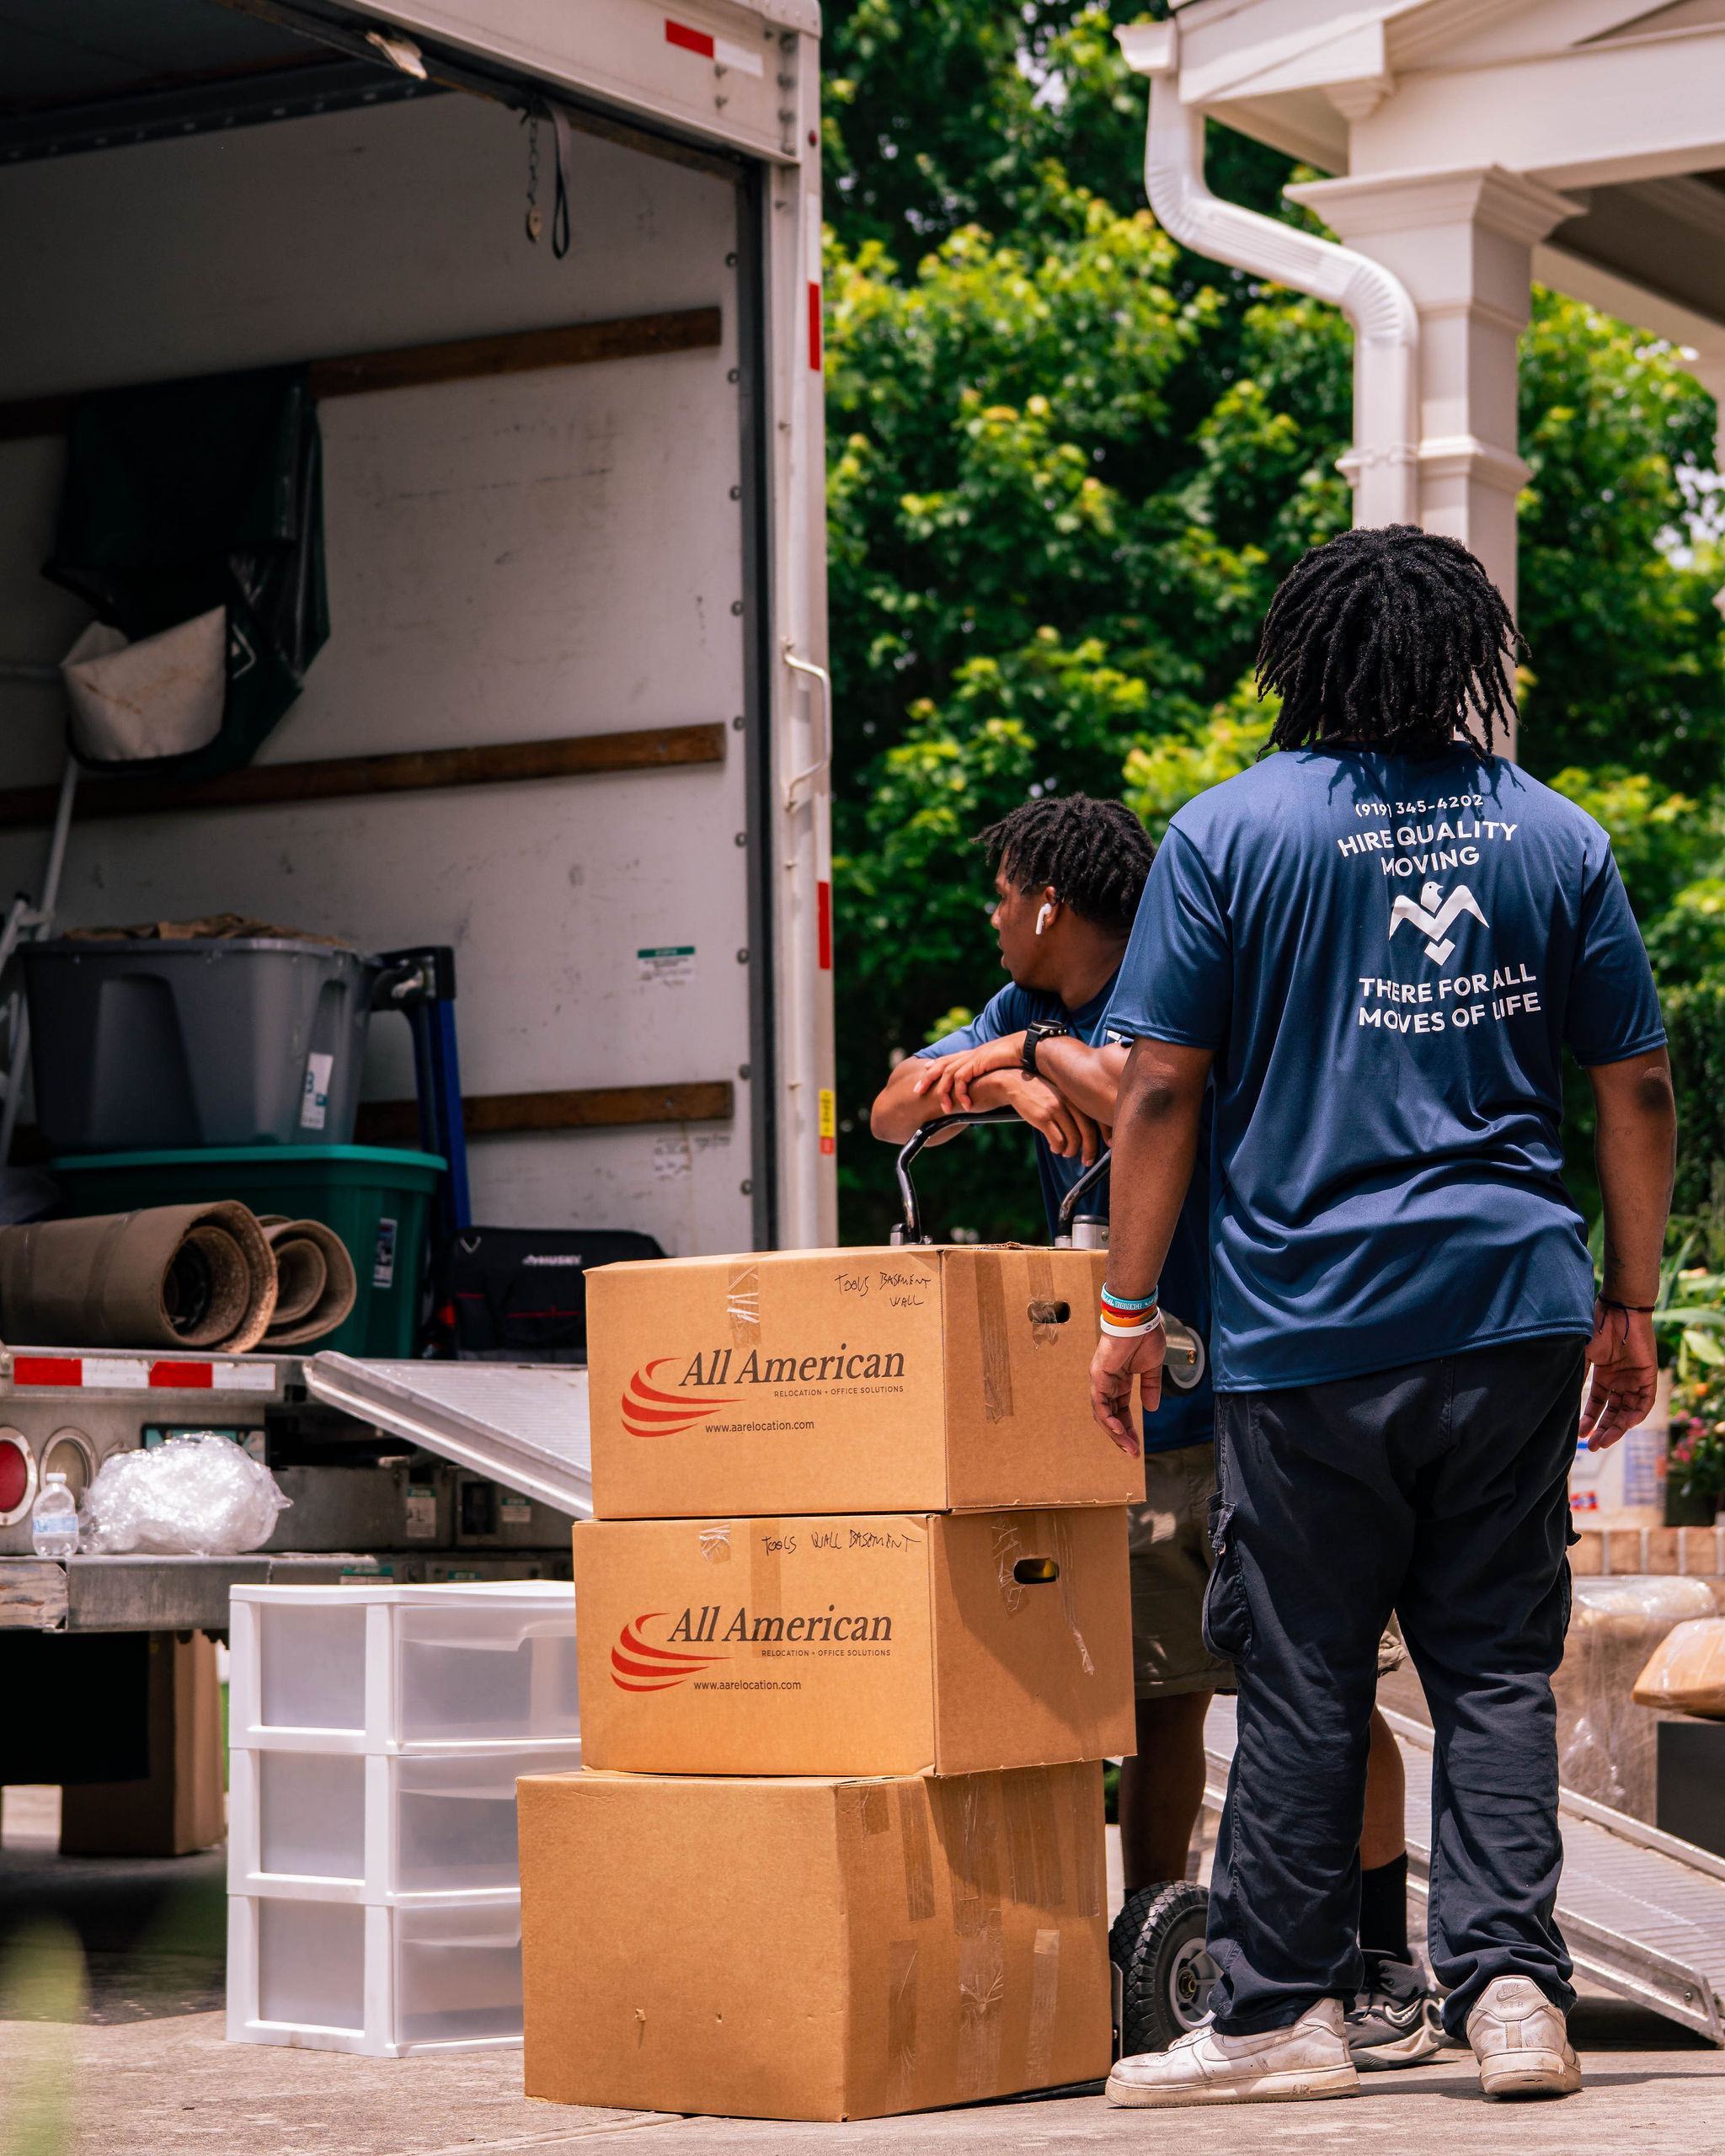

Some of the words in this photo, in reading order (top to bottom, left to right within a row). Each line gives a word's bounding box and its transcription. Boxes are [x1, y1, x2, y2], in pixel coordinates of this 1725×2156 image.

[1354, 803, 1392, 818] (919)
[1396, 794, 1484, 814] 345-4202
[1337, 830, 1395, 857] HIRE
[1397, 820, 1518, 846] QUALITY
[1381, 846, 1480, 877] MOVING
[1359, 978, 1434, 1004] THERE
[1439, 974, 1490, 1000] FOR
[1493, 963, 1537, 990] ALL
[1359, 1006, 1445, 1033] MOVES
[1451, 1004, 1486, 1027] OF
[1492, 992, 1541, 1021] LIFE
[889, 1294, 925, 1308] WALL
[679, 1348, 734, 1387] All
[734, 1342, 905, 1385] American
[774, 1389, 823, 1397] RELOCATION
[830, 1387, 858, 1396] OFFICE
[860, 1385, 904, 1394] SOLUTIONS
[705, 1419, 814, 1433] www.aarelocation.com
[667, 1606, 721, 1642] All
[722, 1604, 892, 1641] American
[761, 1649, 809, 1657] RELOCATION
[818, 1649, 845, 1657] OFFICE
[847, 1649, 891, 1657] SOLUTIONS
[693, 1678, 802, 1691] www.aarelocation.com
